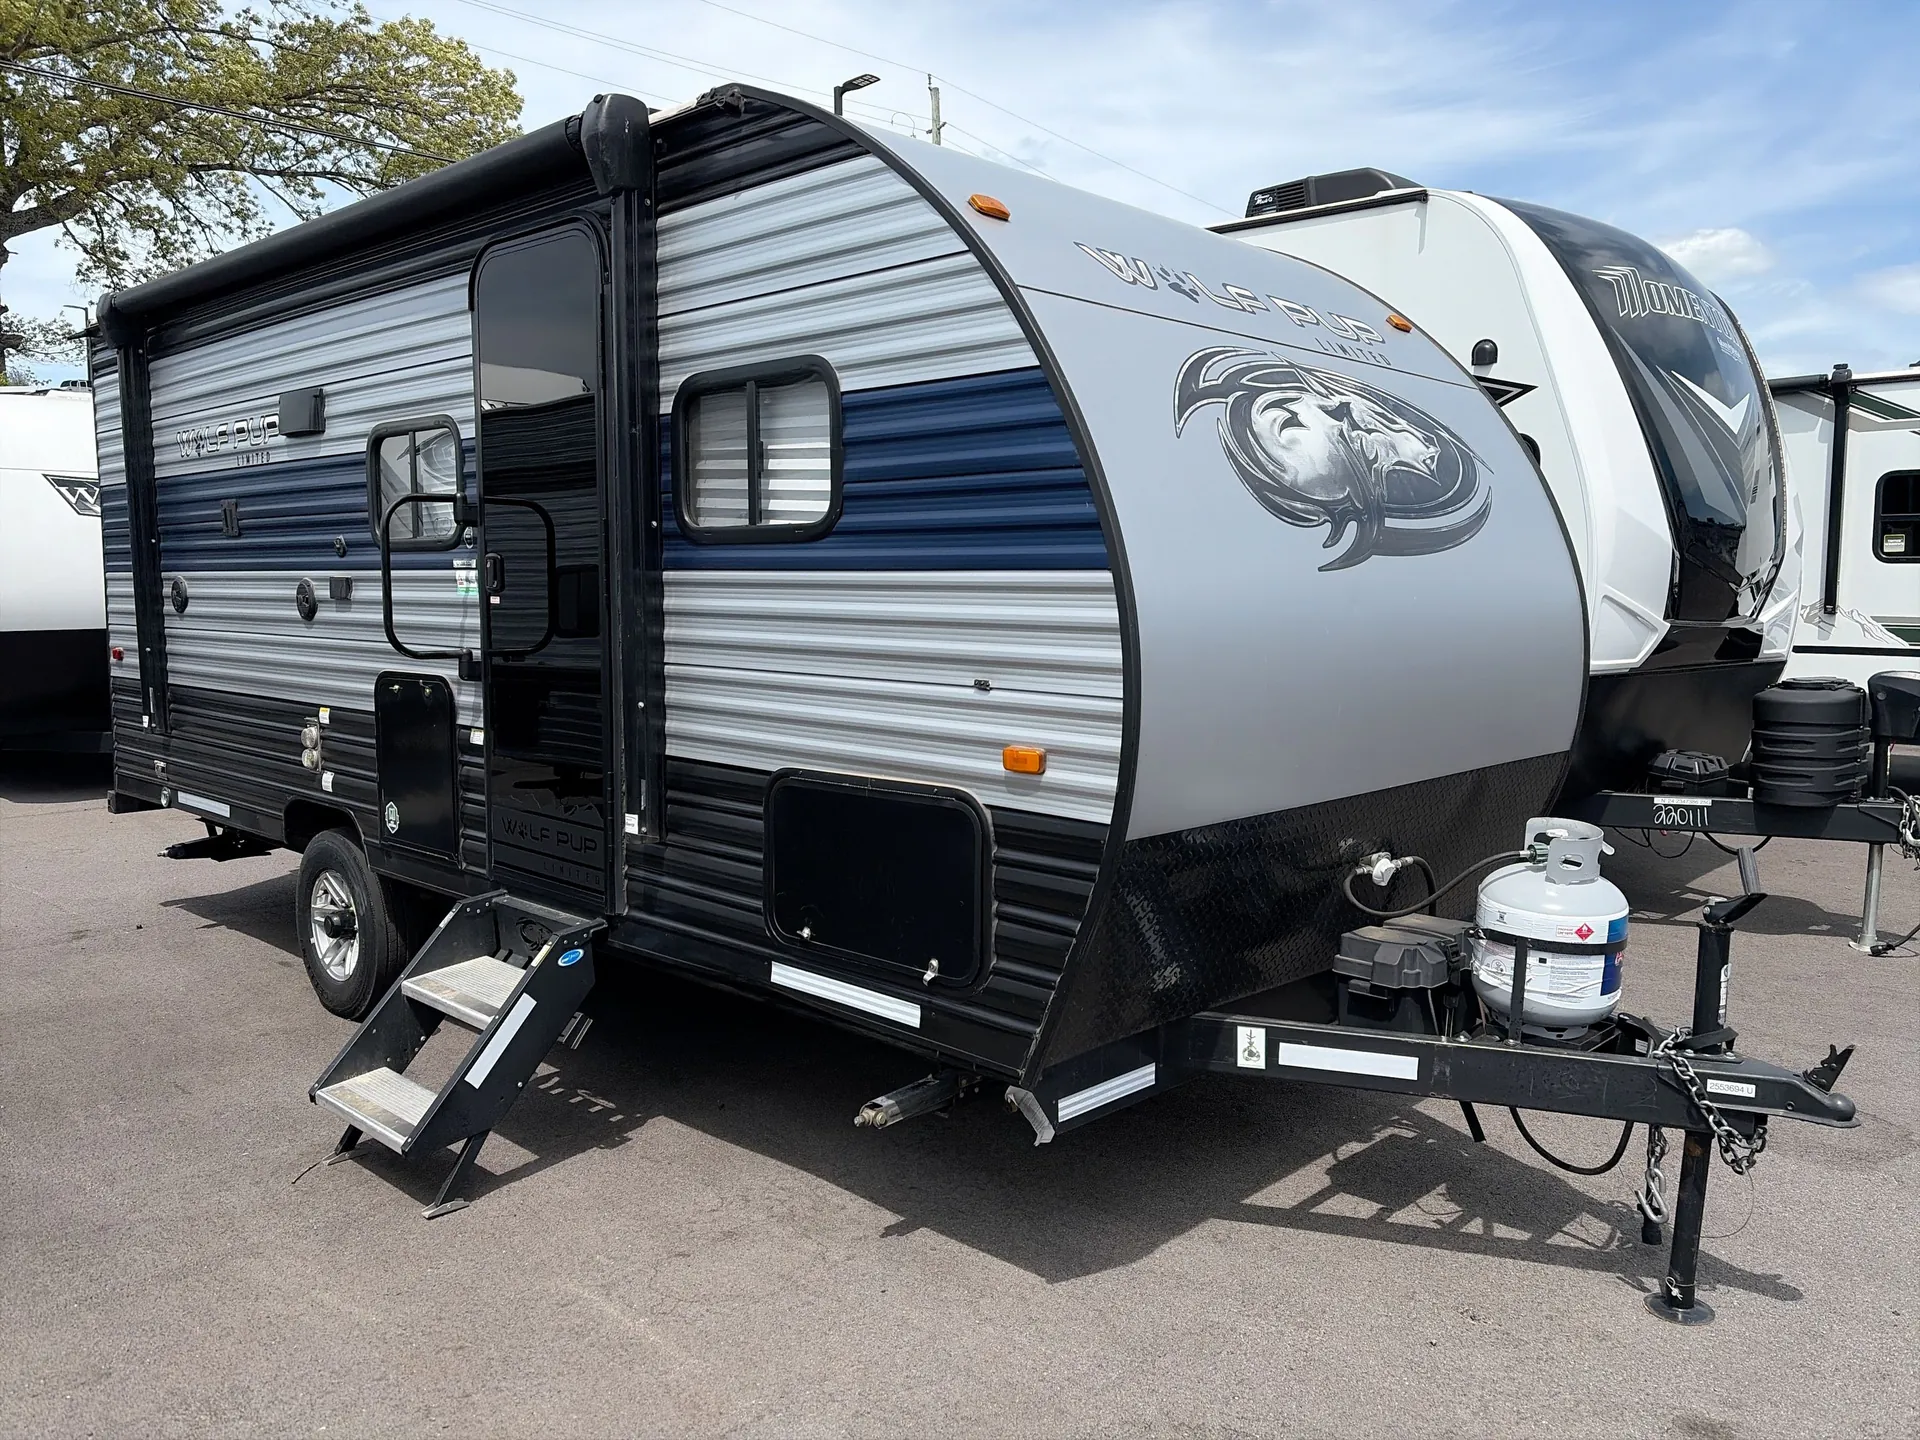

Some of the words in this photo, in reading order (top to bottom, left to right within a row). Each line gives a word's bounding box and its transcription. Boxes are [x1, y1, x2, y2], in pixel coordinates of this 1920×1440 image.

[1265, 293, 1386, 346] PUP
[1314, 337, 1392, 366] LIMITED
[233, 412, 280, 449] PUP
[236, 451, 271, 466] LIMITED
[1653, 804, 1708, 827] 220111
[556, 831, 598, 854] PUP
[543, 861, 601, 886] LIMITED
[1709, 1082, 1745, 1093] 2553694
[1746, 1087, 1754, 1095] U
